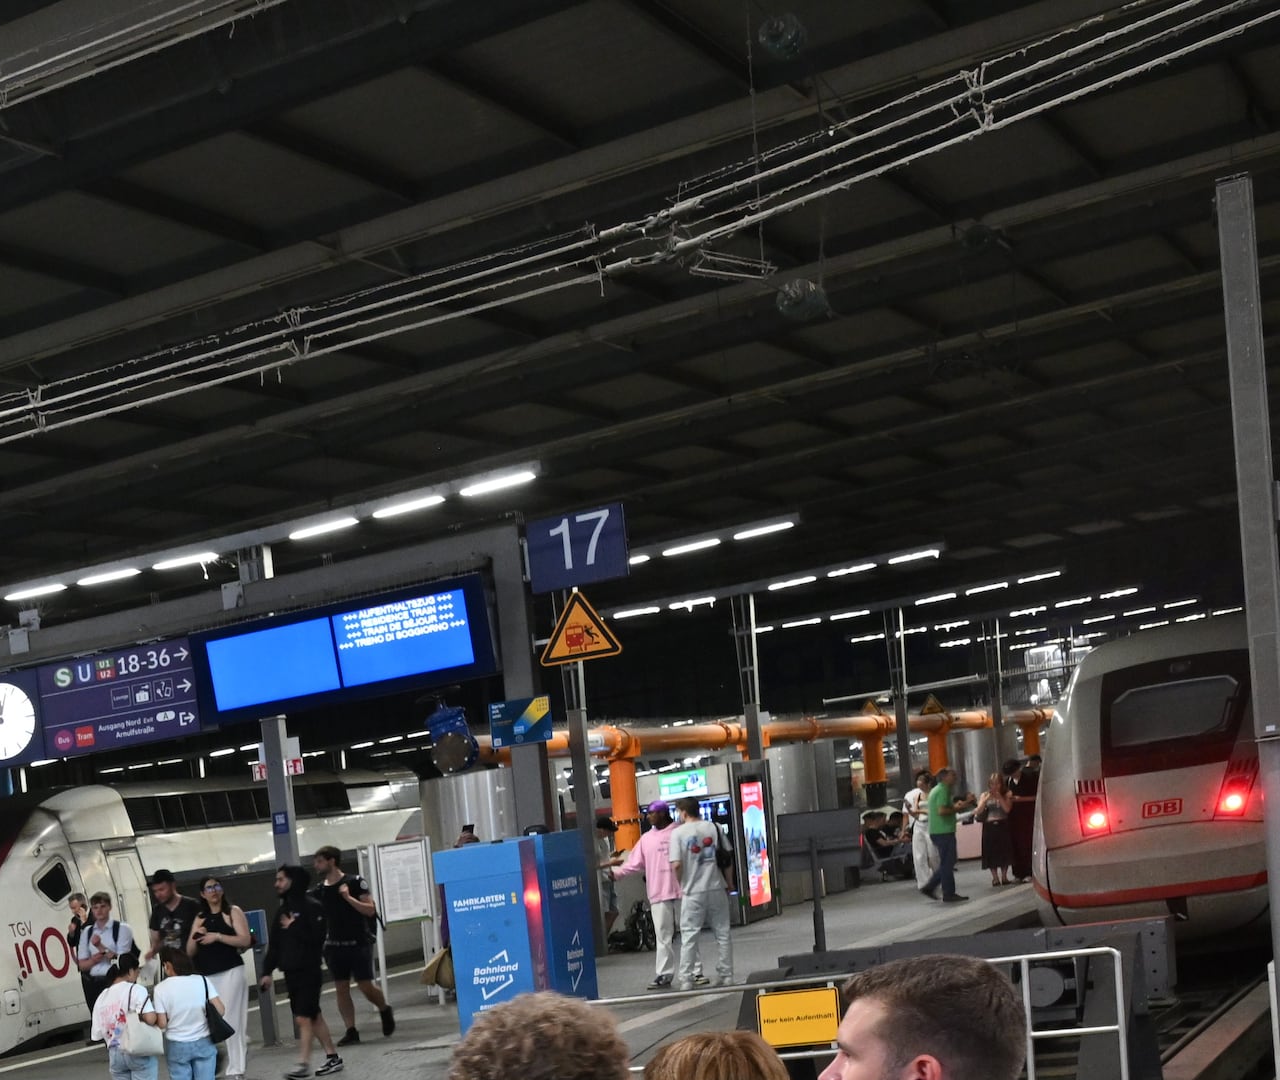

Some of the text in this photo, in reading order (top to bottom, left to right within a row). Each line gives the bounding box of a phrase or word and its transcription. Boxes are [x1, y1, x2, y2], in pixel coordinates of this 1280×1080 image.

[549, 509, 610, 570] 17
[410, 605, 437, 618] TRAIN
[362, 624, 388, 637] TRAIN
[389, 622, 402, 631] DE
[354, 634, 385, 648] TRENO
[385, 631, 395, 641] DI
[55, 648, 171, 687] S U 18-36
[99, 660, 110, 668] U1
[100, 670, 112, 678] U2
[98, 720, 125, 733] Ausgang
[125, 717, 142, 728] Nord
[143, 716, 154, 724] Exit
[58, 733, 93, 744] Bus Tram
[115, 726, 155, 739] Arnulfstraße
[1145, 800, 1181, 818] DB
[453, 893, 506, 909] FAHRKARTEN
[8, 920, 32, 938] TGV
[473, 962, 519, 977] Bahnland
[473, 975, 505, 985] Bayern
[763, 1011, 836, 1025] Hier kein Aufenthalt!
